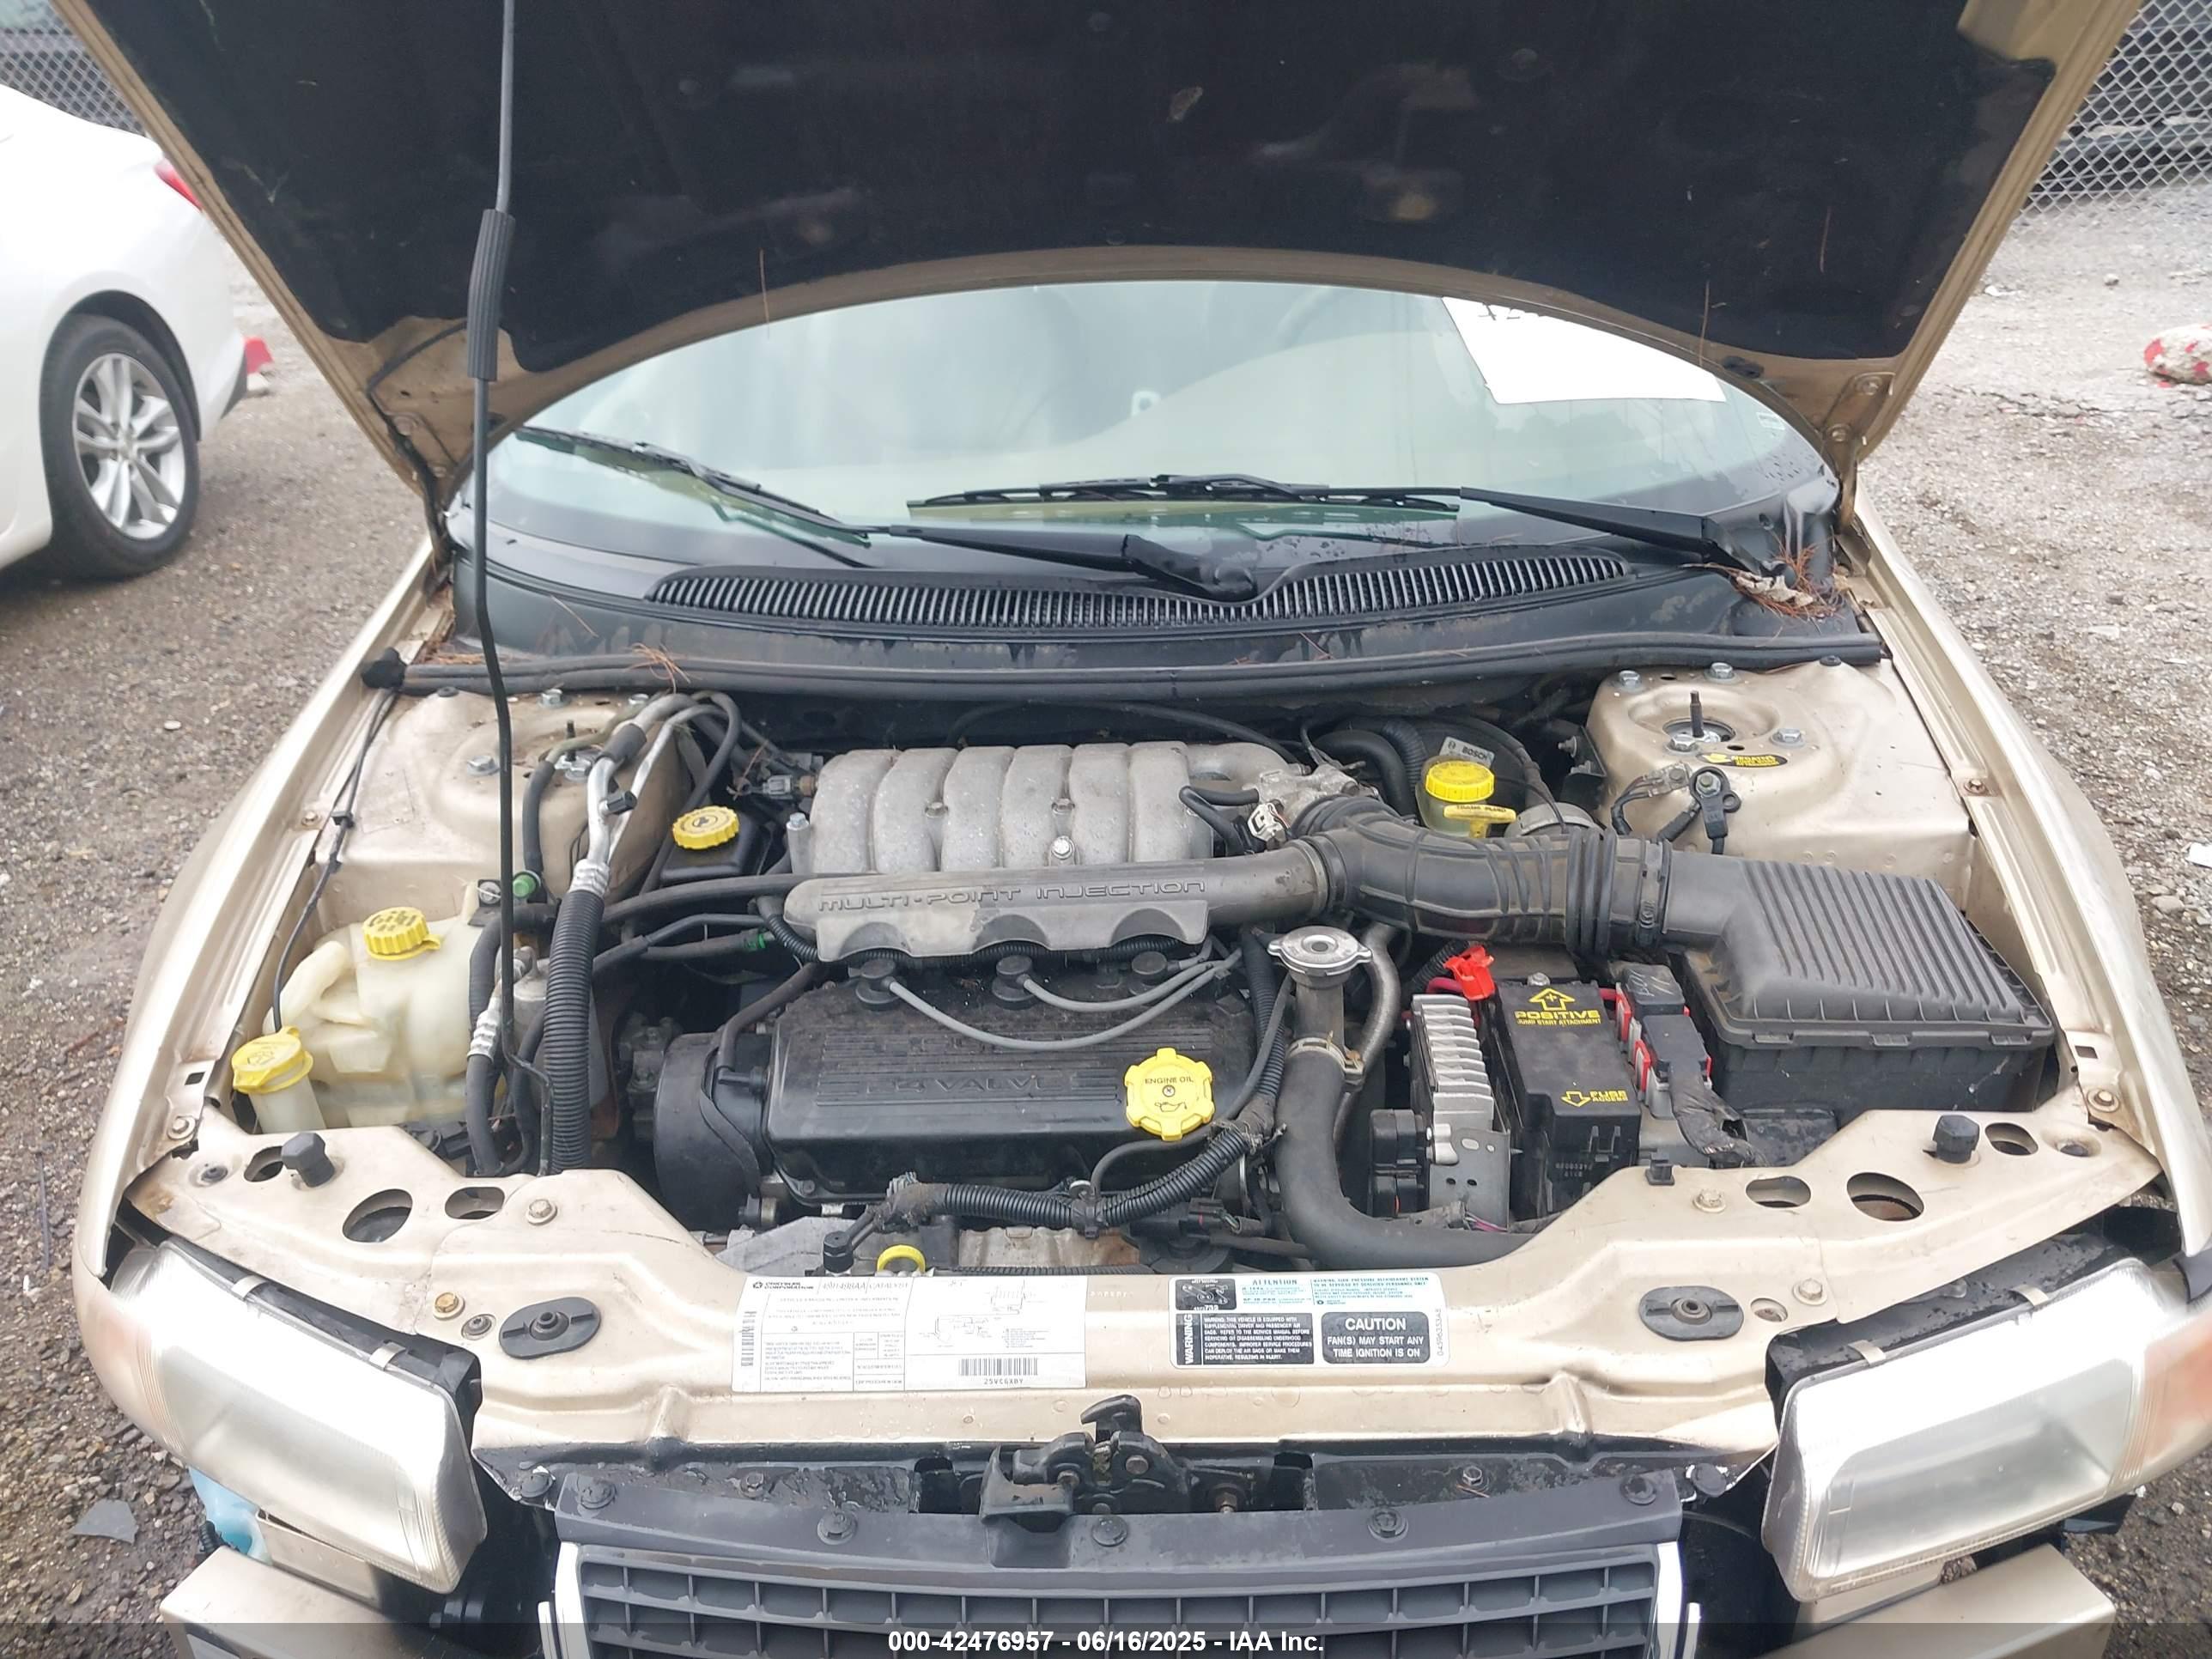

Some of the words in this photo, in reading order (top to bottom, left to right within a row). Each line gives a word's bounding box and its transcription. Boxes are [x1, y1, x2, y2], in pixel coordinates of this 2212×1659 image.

[1462, 745, 1488, 761] BOSCH
[1036, 878, 1206, 899] INJECTION
[1514, 1010, 1601, 1020] POSITIVE
[1345, 1317, 1407, 1331] CAUTION
[1183, 1314, 1194, 1364] WARNING
[1327, 1336, 1356, 1346] FAN(S)
[1358, 1335, 1376, 1345] MAY
[1378, 1335, 1404, 1345] START
[1407, 1335, 1424, 1345] ANY
[1333, 1348, 1352, 1358] TIME
[1355, 1348, 1392, 1358] IGNITION
[1395, 1348, 1404, 1358] IS
[1407, 1348, 1420, 1358] ON
